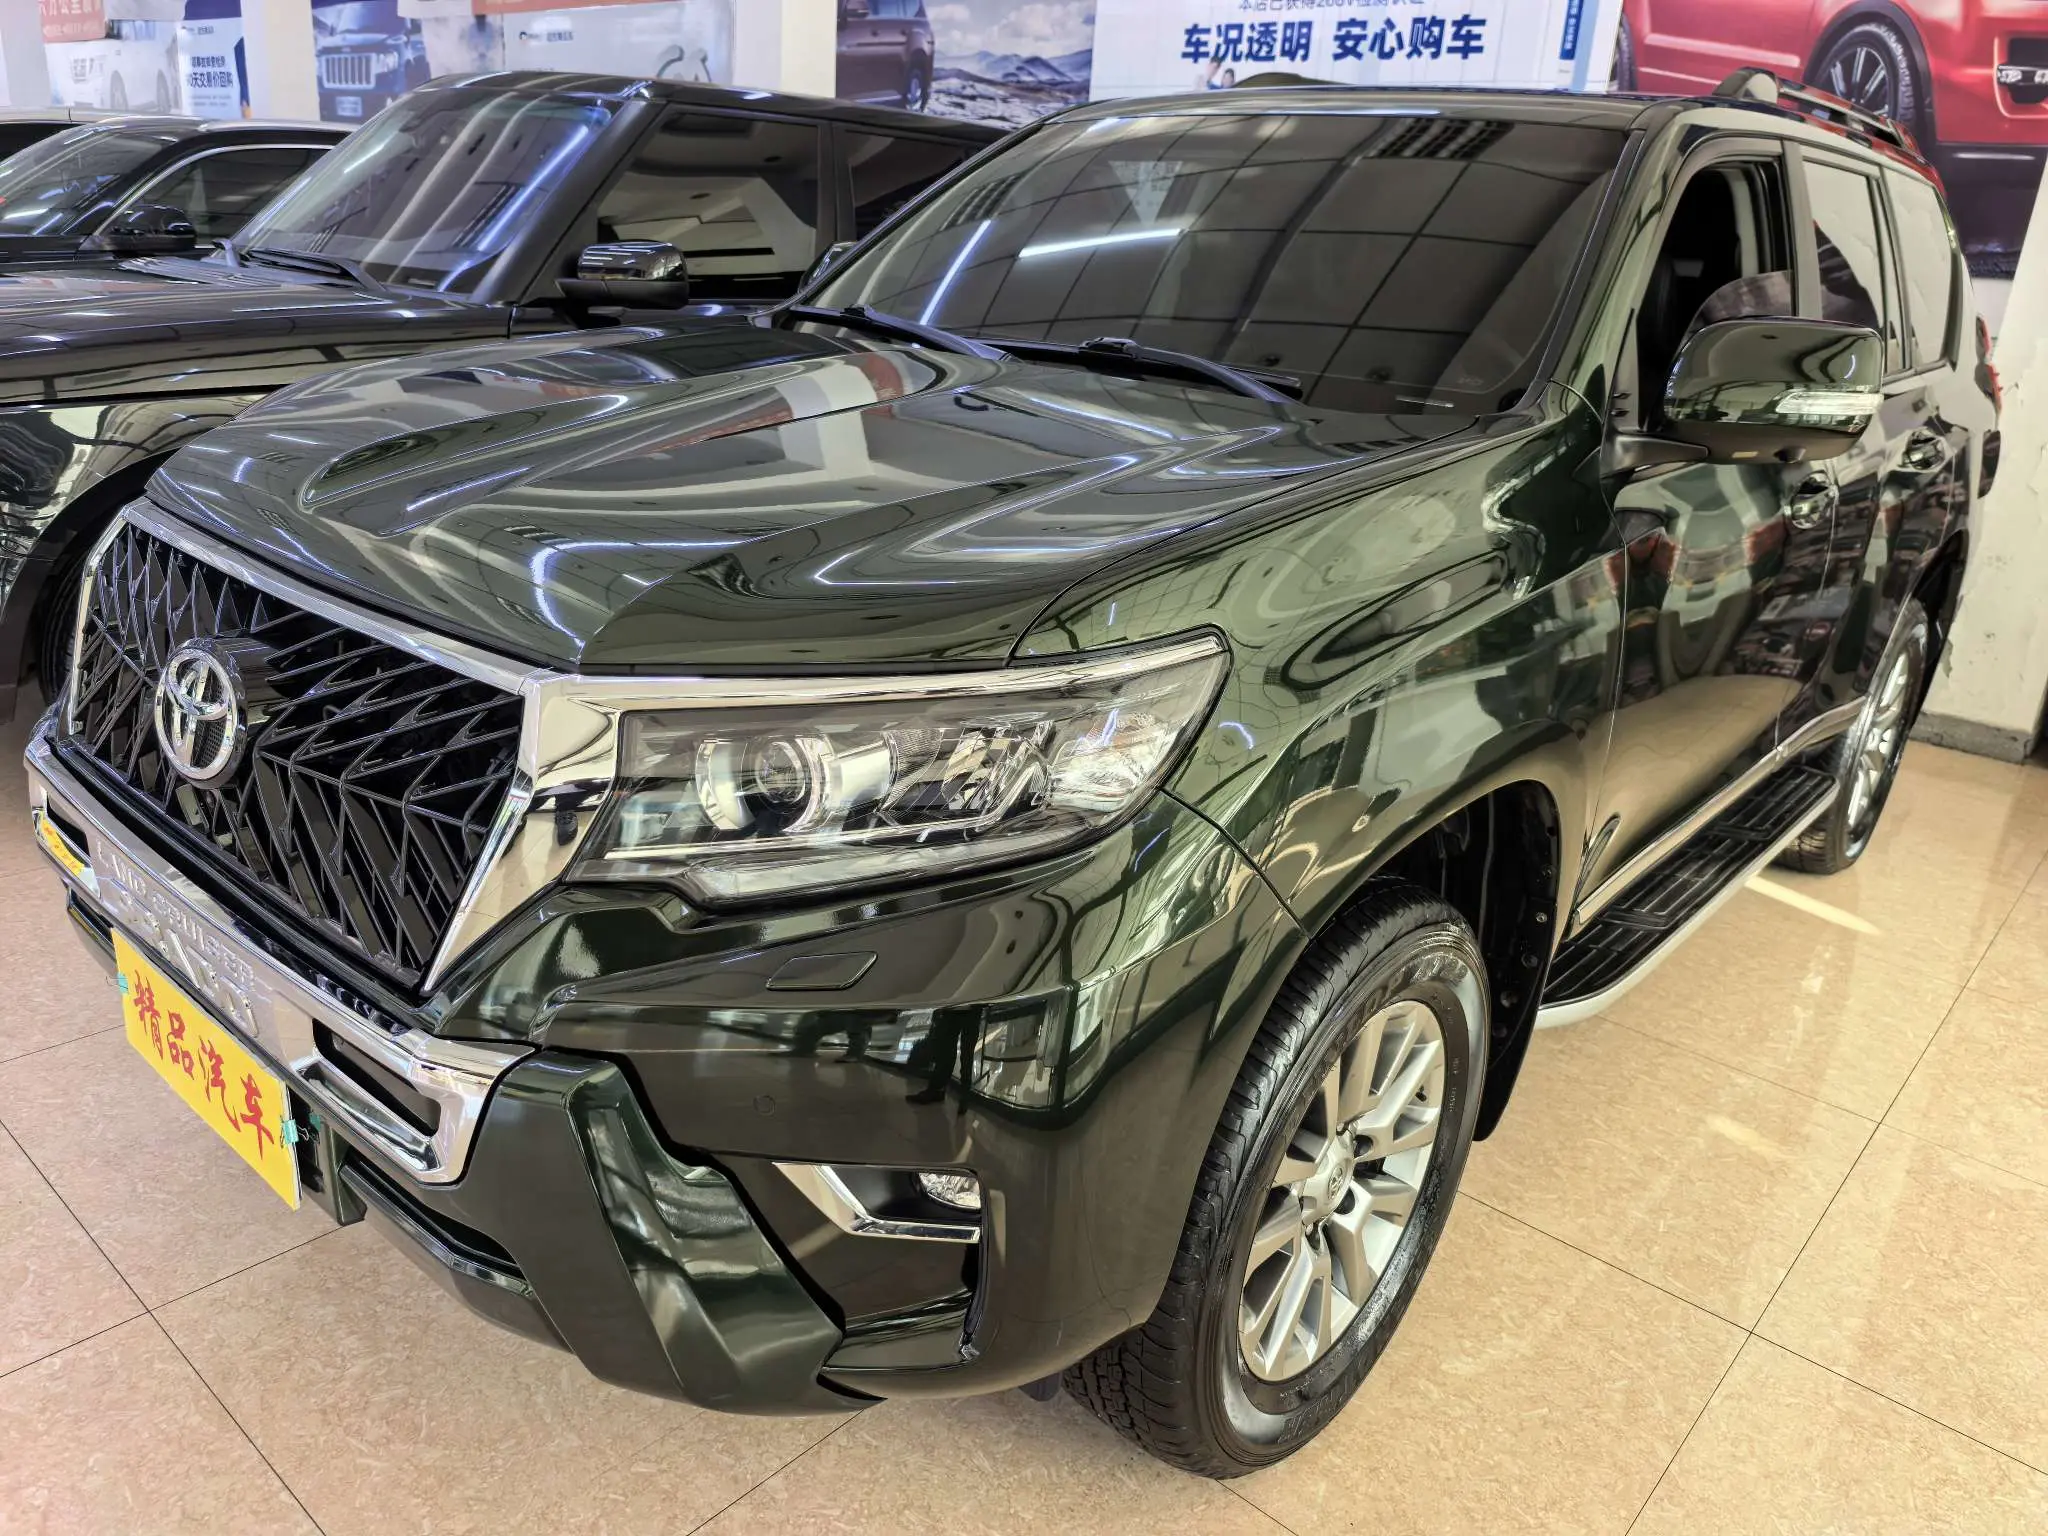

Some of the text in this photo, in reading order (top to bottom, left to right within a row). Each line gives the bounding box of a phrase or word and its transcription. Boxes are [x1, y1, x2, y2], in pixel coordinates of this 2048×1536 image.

[1181, 14, 1486, 63] 车况透明 安心购车
[152, 889, 256, 992] CRUISER
[133, 969, 275, 1160] 精品汽车
